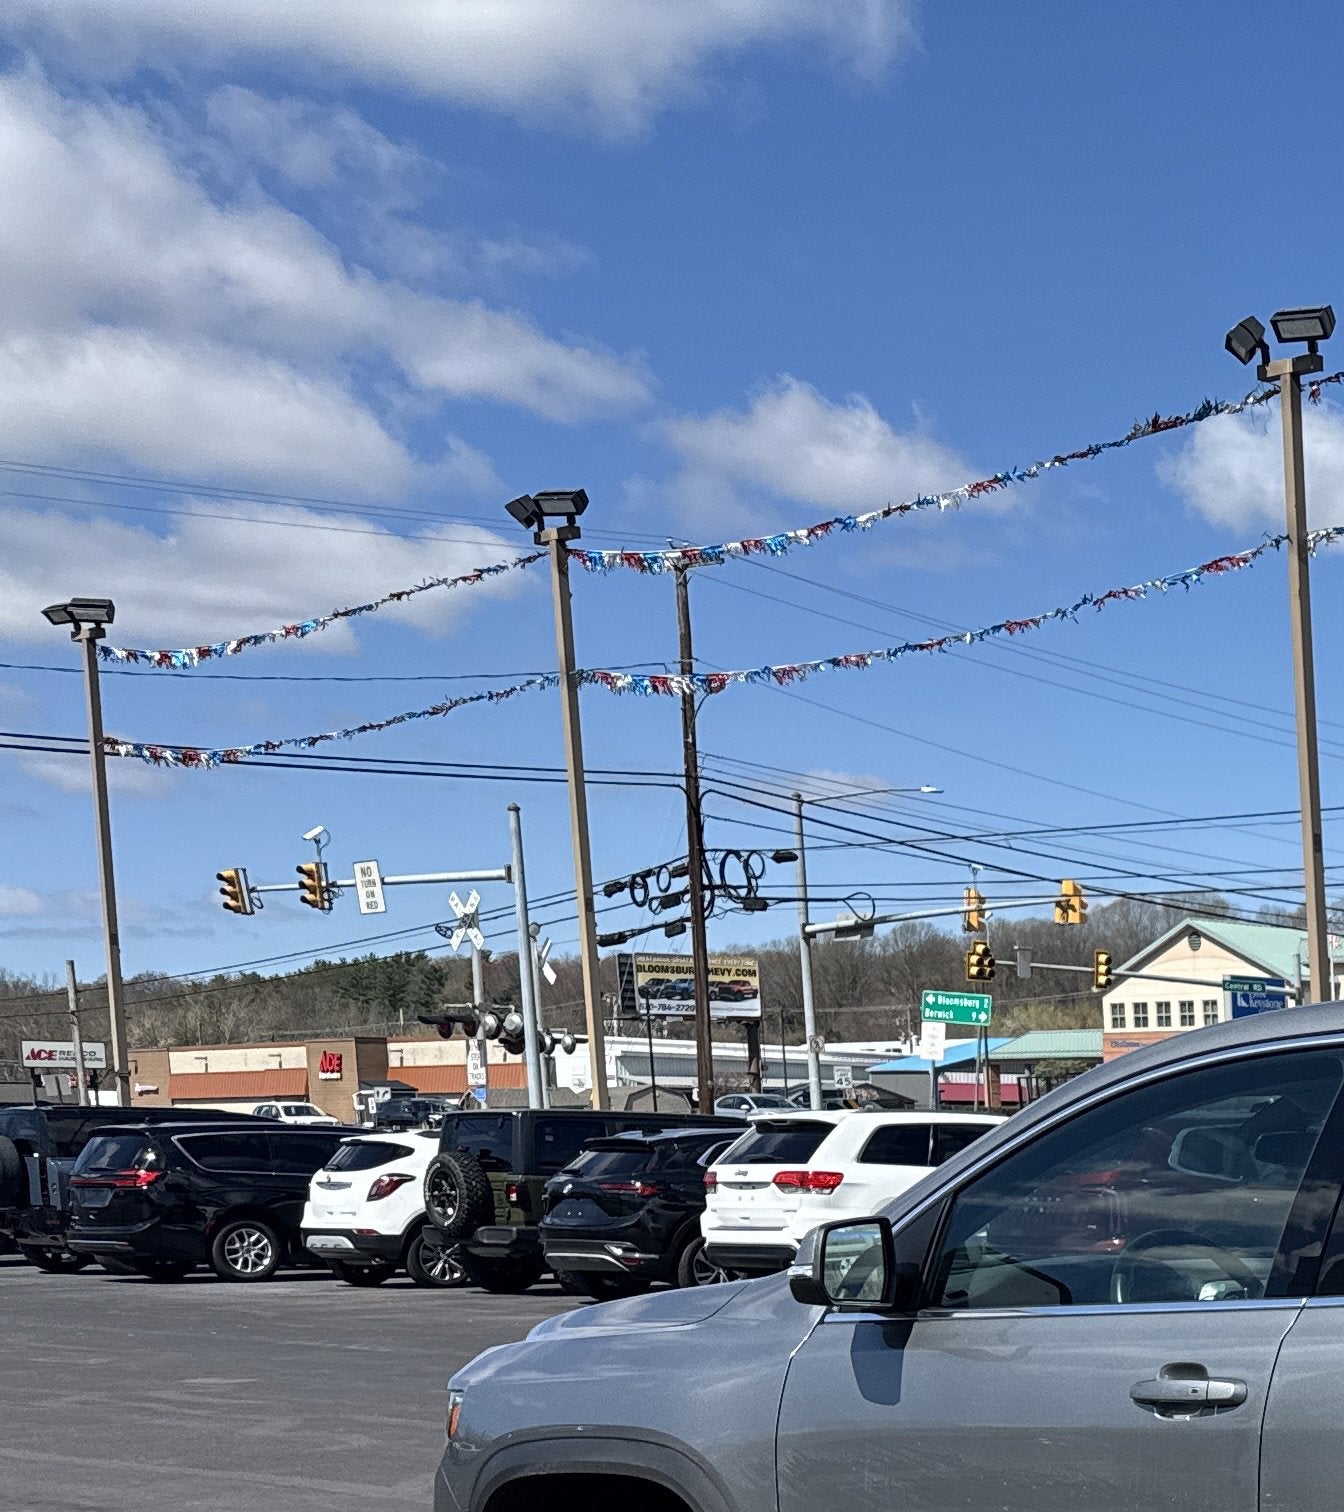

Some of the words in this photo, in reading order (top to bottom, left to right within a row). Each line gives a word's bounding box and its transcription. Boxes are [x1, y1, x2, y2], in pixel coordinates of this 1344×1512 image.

[360, 866, 372, 877] NO
[636, 963, 757, 978] BLOOMSBURHEVY.COM
[1224, 982, 1250, 990] Central
[937, 994, 980, 1009] Bloomsburg
[984, 998, 989, 1008] 2
[924, 1008, 954, 1019] Berwick
[971, 1011, 977, 1021] 9
[25, 1047, 58, 1061] ACE
[320, 1050, 342, 1073] ACE
[836, 1077, 852, 1087] 45
